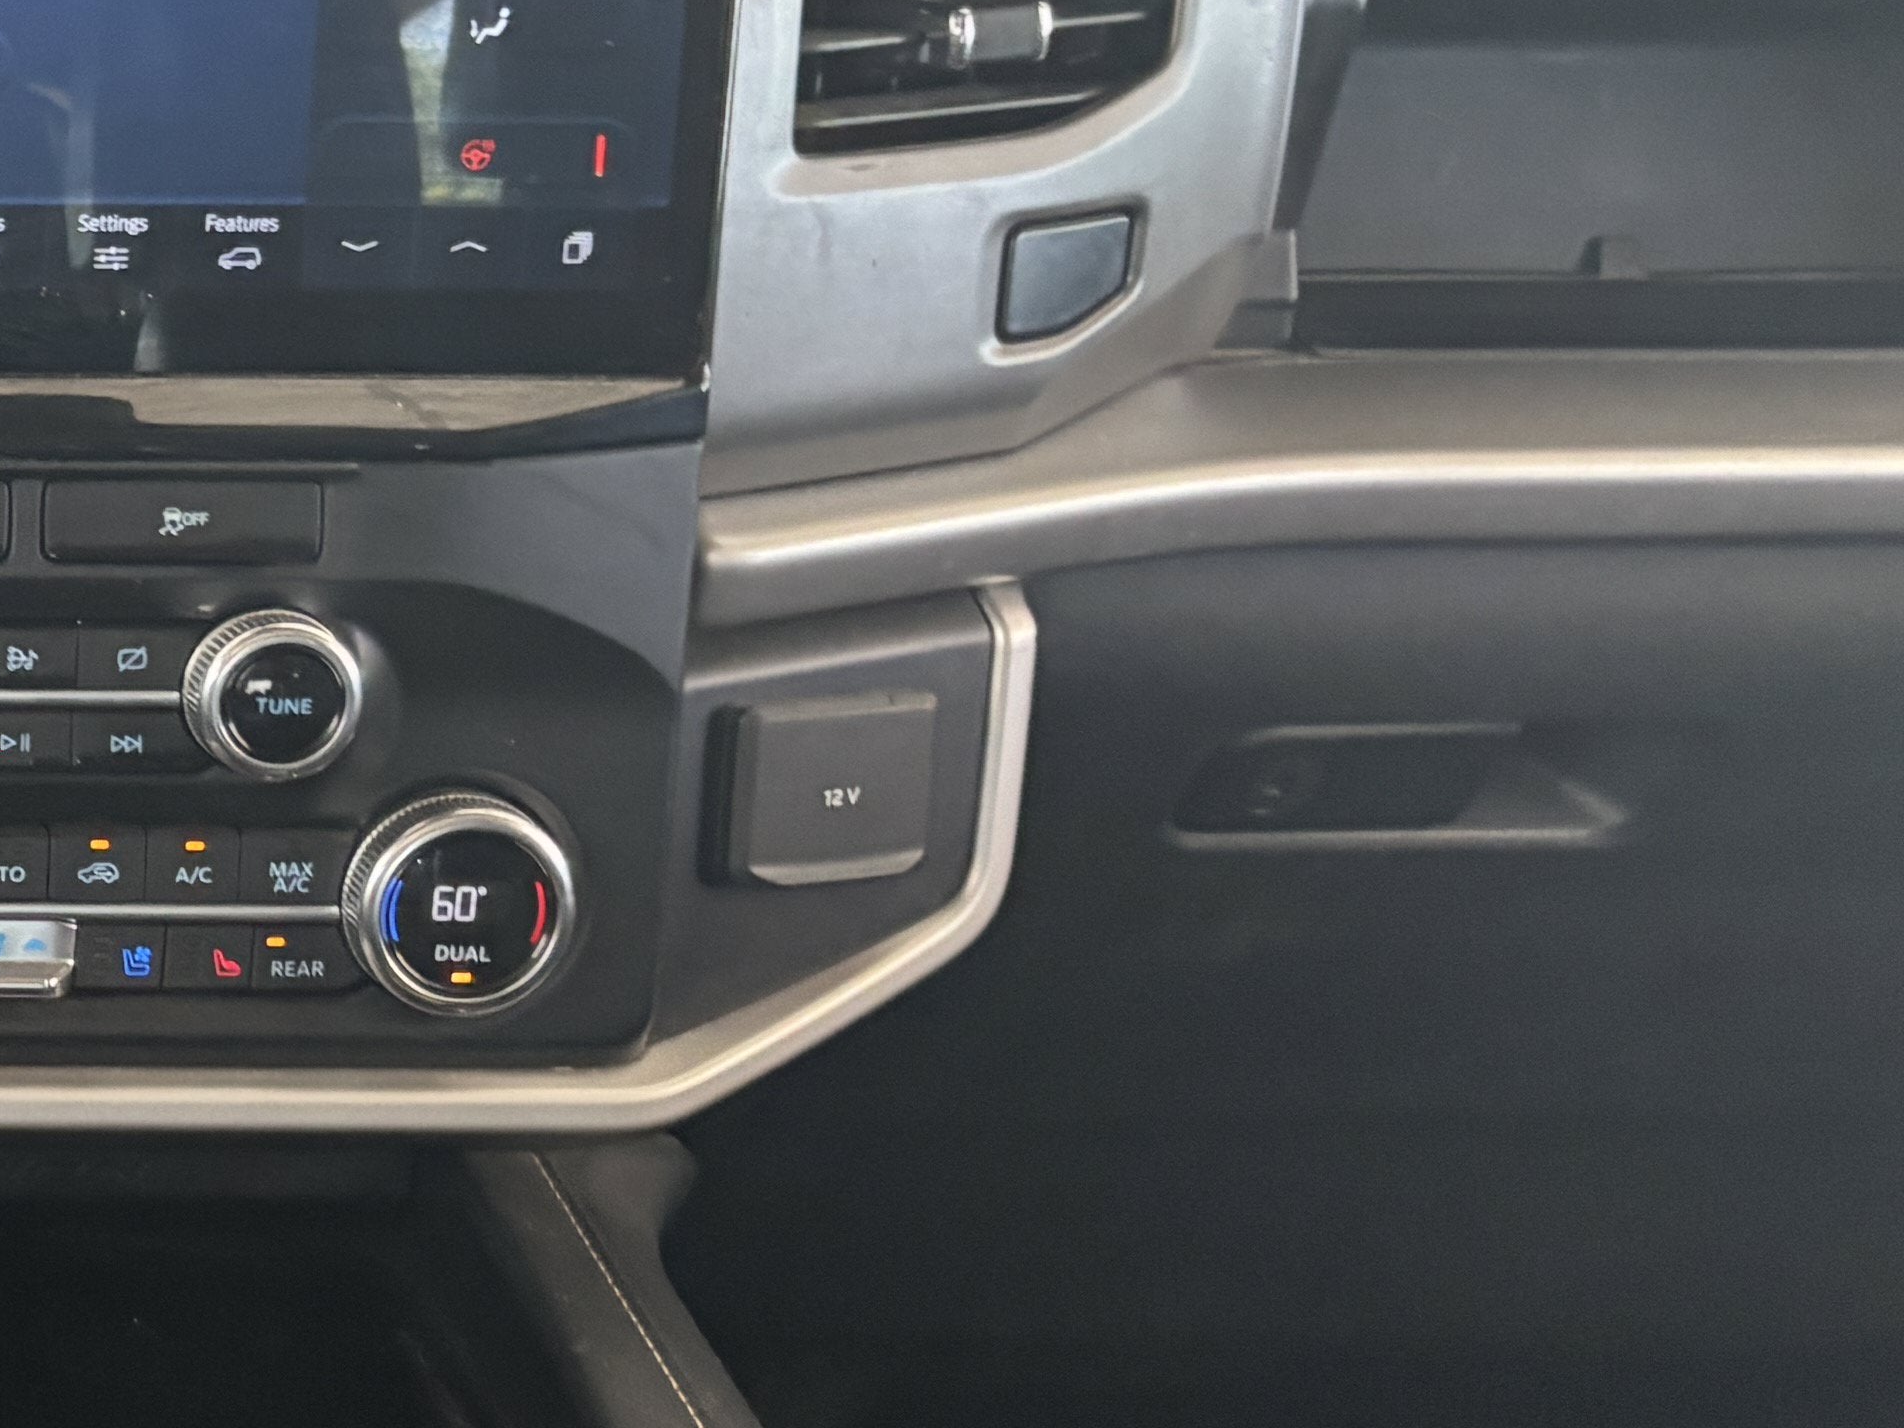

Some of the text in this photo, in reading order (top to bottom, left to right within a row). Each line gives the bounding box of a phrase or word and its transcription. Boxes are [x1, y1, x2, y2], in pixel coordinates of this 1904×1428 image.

[77, 213, 149, 237] Settings
[204, 213, 280, 234] Features
[182, 511, 210, 527] OFF
[256, 697, 314, 717] TUNE
[175, 866, 213, 885] A/C
[269, 861, 314, 879] MAX
[273, 876, 310, 894] A/C
[430, 885, 488, 923] 60°
[434, 944, 491, 963] DUAL
[271, 960, 325, 978] REAR
